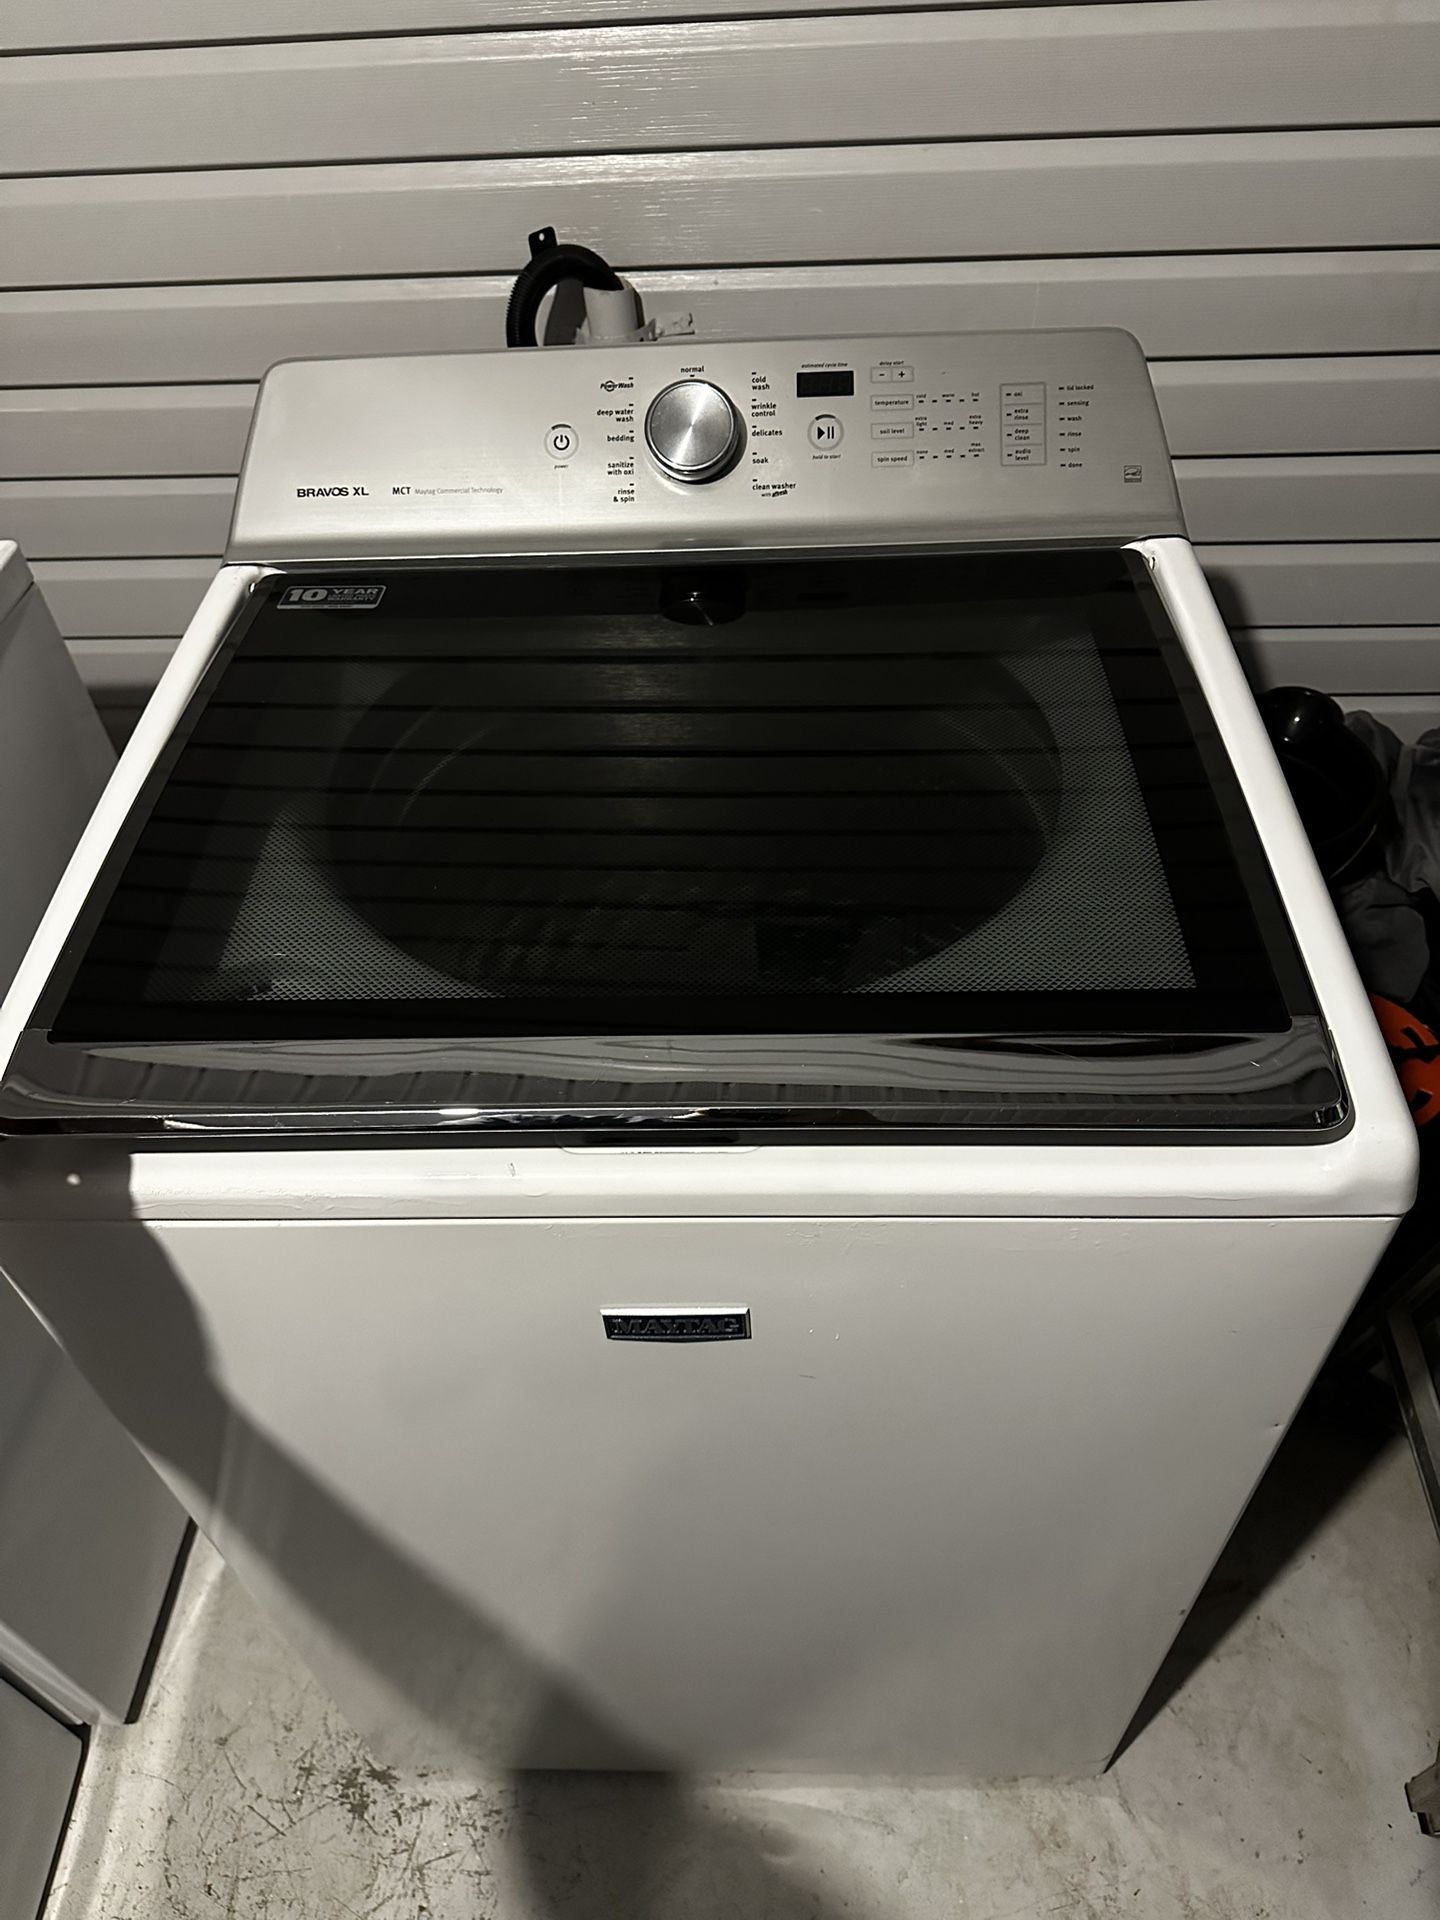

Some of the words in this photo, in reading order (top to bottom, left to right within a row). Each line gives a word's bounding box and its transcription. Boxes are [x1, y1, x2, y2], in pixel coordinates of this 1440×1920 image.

[680, 365, 704, 374] normal
[296, 486, 350, 498] BRAVOS
[352, 487, 370, 496] XL
[392, 486, 412, 496] MCT
[471, 486, 504, 494] Technology
[289, 588, 328, 602] 10
[612, 1318, 740, 1334] MAYTAG
